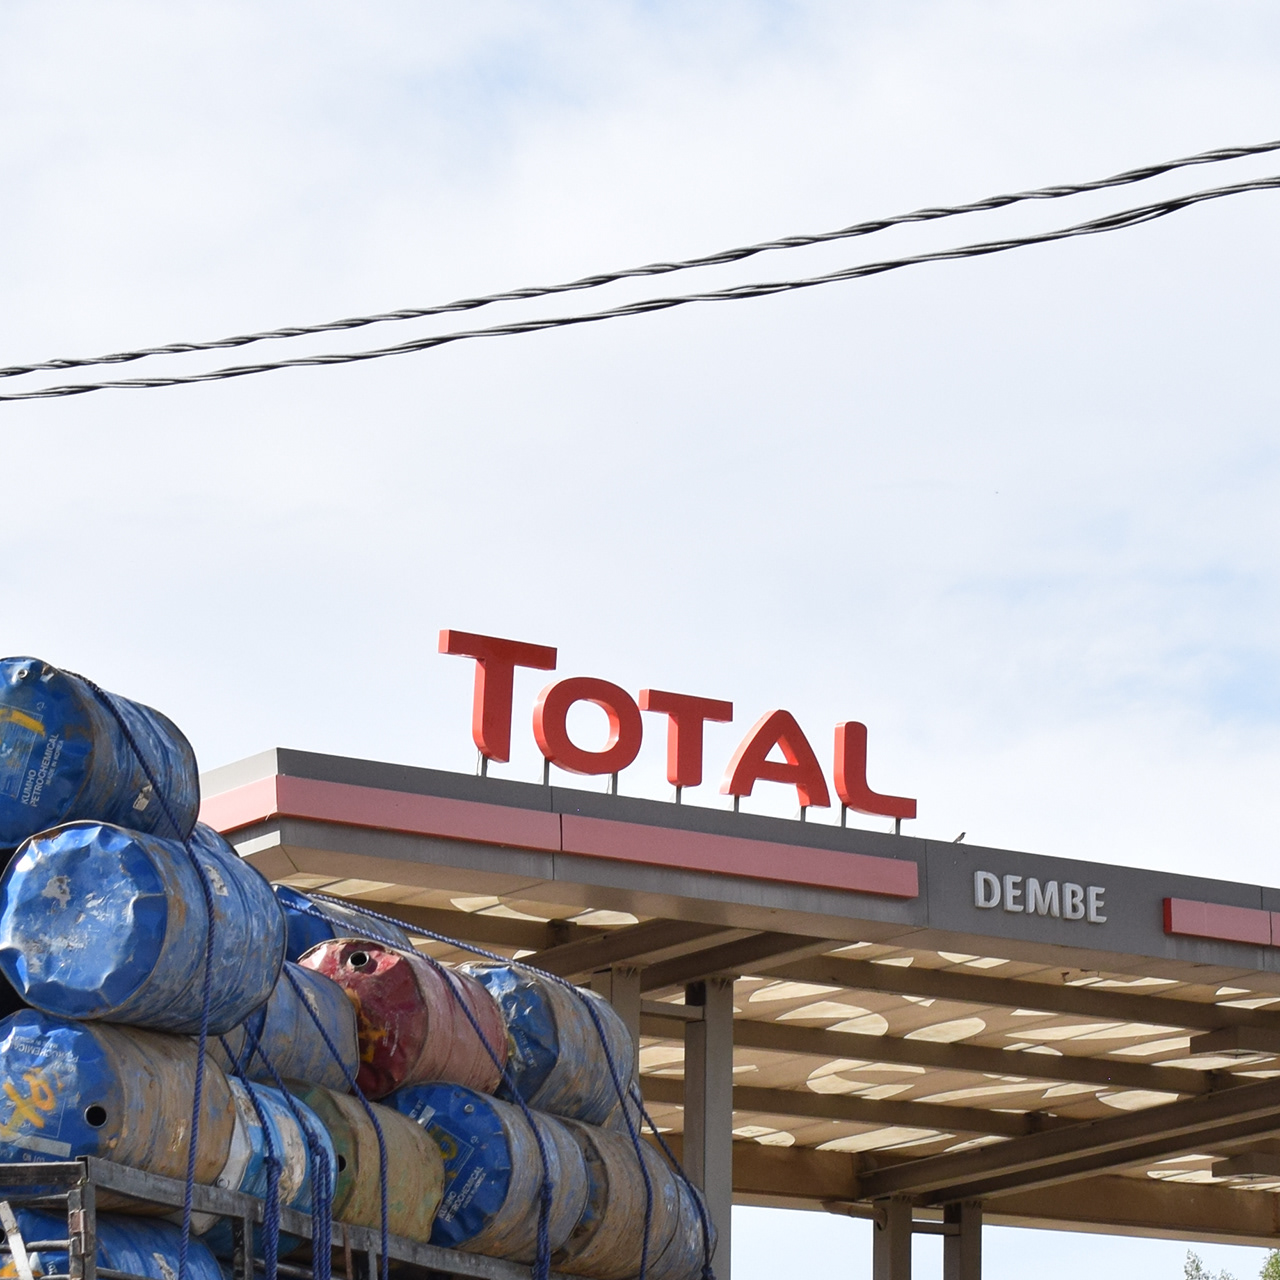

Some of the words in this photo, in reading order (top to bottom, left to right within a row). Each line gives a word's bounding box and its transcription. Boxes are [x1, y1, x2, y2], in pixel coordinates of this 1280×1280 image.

[439, 629, 917, 819] TOTAL
[21, 770, 37, 804] KUMHO
[30, 733, 59, 807] PETROCHEMICAL
[974, 870, 1107, 923] DEMBE
[445, 1166, 484, 1222] PETROCHEMICAL
